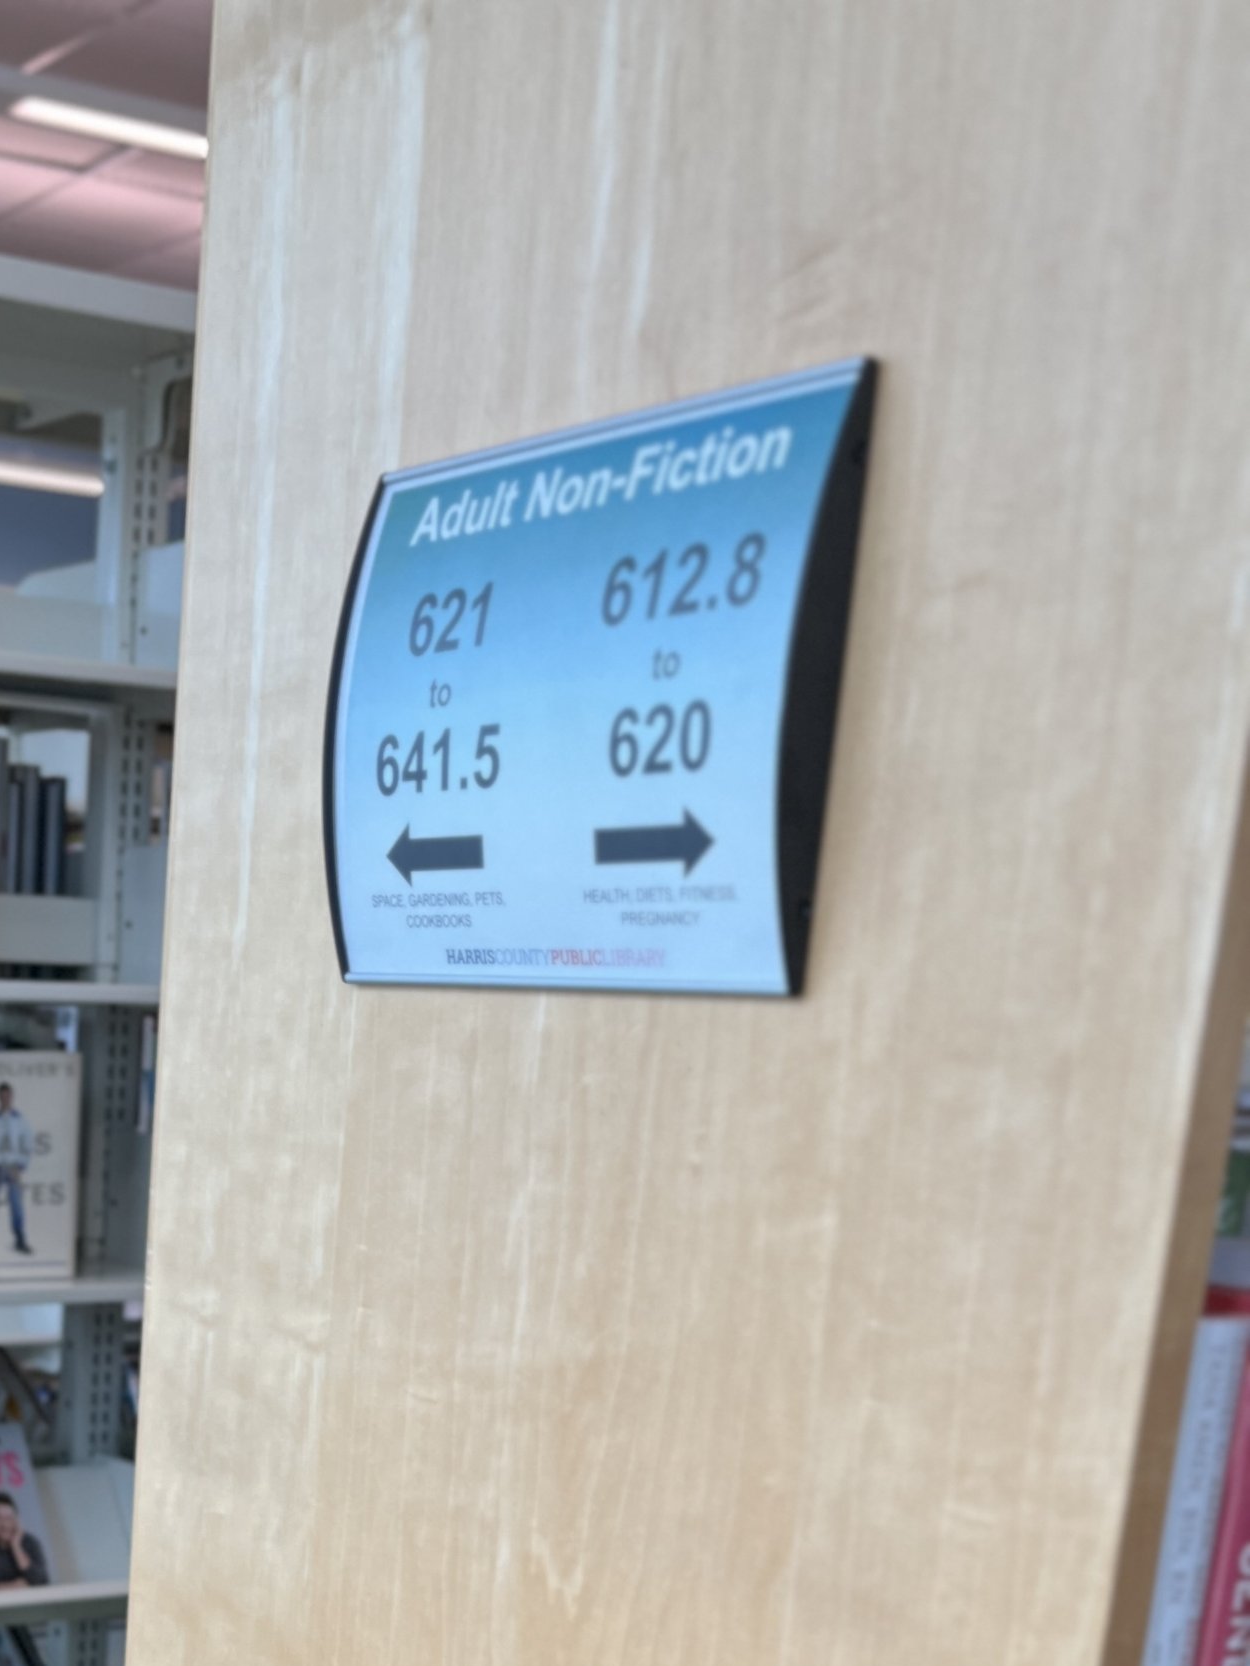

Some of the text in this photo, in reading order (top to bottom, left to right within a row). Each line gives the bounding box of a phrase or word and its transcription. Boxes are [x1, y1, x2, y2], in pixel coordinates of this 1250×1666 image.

[409, 424, 793, 547] Adult Non-Fiction
[600, 531, 767, 628] 612.8
[408, 580, 494, 658] 621
[652, 647, 681, 680] to
[428, 677, 452, 709] to
[375, 723, 502, 798] 641.5
[609, 699, 713, 779] 620
[371, 890, 506, 909] SPACE, GARDENING, PETS,
[406, 914, 472, 929] COOKBOOKS
[620, 911, 700, 927] PREGNANCY
